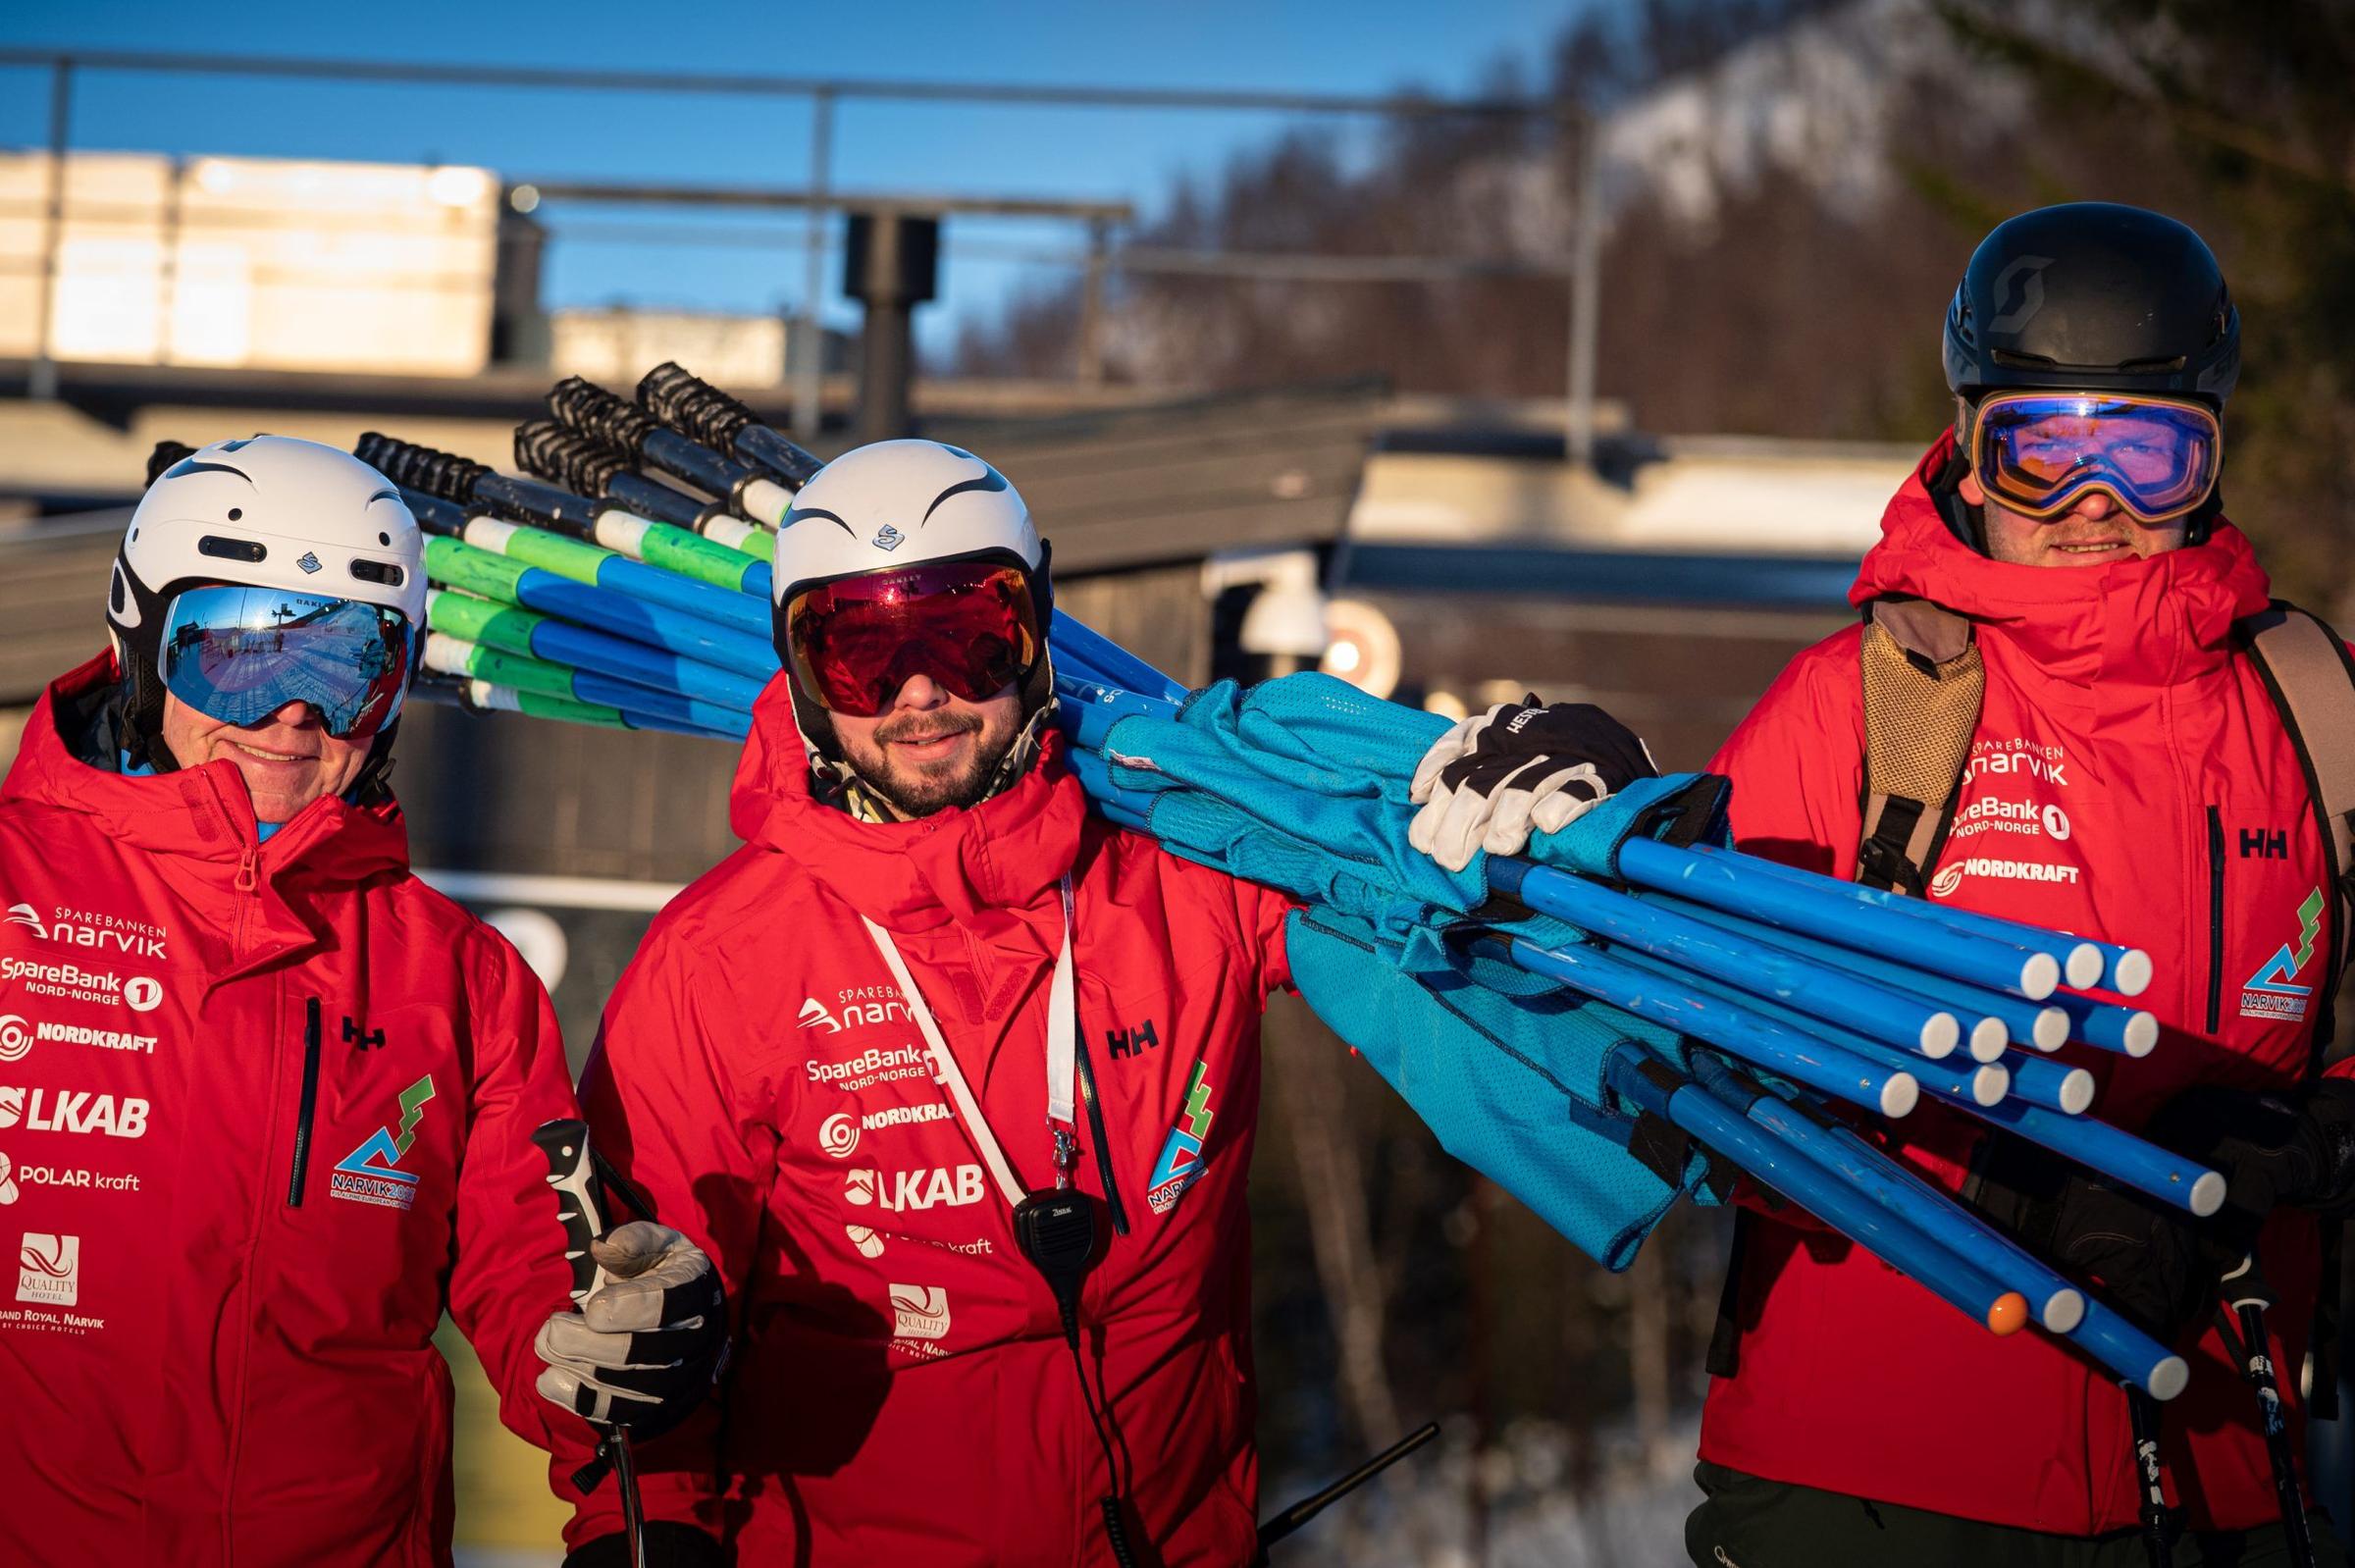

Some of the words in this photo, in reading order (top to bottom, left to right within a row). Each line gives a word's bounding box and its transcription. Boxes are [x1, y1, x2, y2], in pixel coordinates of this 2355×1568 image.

[1972, 738, 2064, 759] SPAREBANKEN
[1970, 753, 2067, 786] narvik
[1956, 820, 2040, 839] NORD-NORGE
[1963, 859, 2079, 884] NORDKRAFT
[55, 907, 167, 938] SPAREBANKEN
[53, 922, 168, 960] narvik
[1, 957, 122, 991] SpareBank
[26, 981, 120, 1005] NORD-NORGE
[37, 1022, 157, 1055] NORDKRAFT
[1106, 1019, 1159, 1060] HH
[806, 1044, 923, 1083] SpareBank
[839, 1067, 926, 1092] NORD-NORGE
[26, 1088, 150, 1138] LKAB
[20, 1166, 90, 1187] POLAR
[95, 1173, 140, 1191] kraft
[876, 1164, 985, 1213] LKAB
[948, 1237, 993, 1255] kraft
[21, 1275, 75, 1293] QUALITY
[31, 1291, 64, 1301] HOTEL
[16, 1323, 46, 1332] CHOICE
[50, 1326, 85, 1335] HOTELS
[25, 1309, 61, 1325] ROYAL,
[64, 1313, 105, 1329] NARVIK
[898, 1314, 947, 1332] QUALITY
